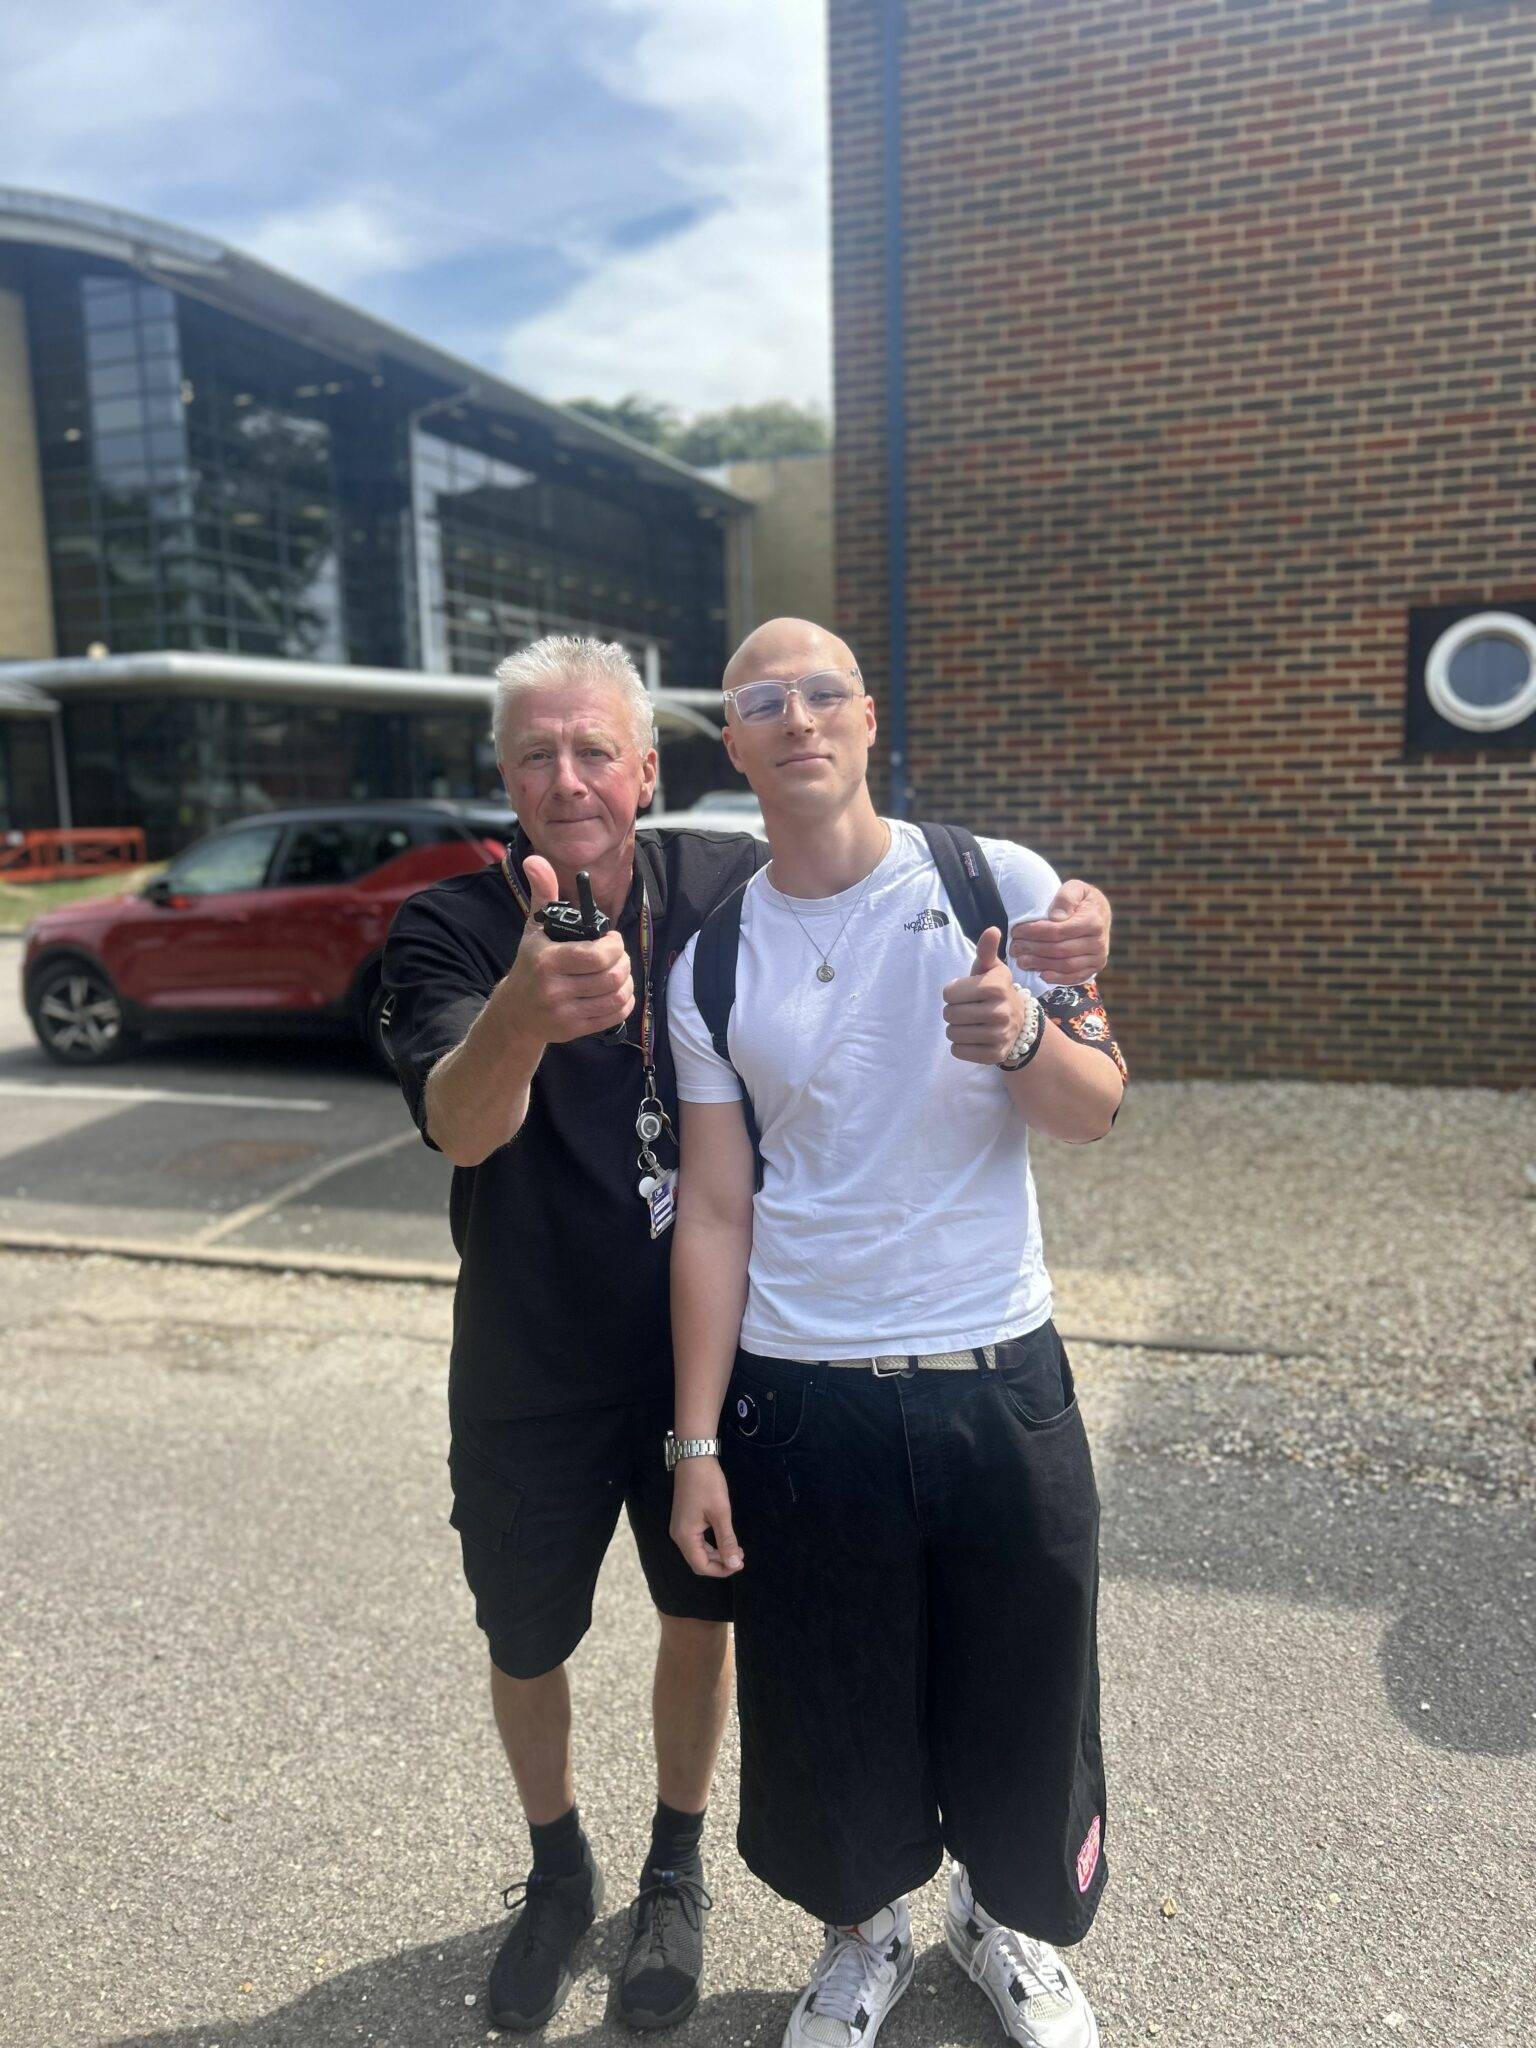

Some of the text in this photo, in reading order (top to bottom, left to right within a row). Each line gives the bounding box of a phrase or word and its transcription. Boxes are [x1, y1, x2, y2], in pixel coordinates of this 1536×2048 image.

[916, 909, 931, 919] THE
[904, 916, 933, 931] NORTH
[913, 922, 934, 935] FACE
